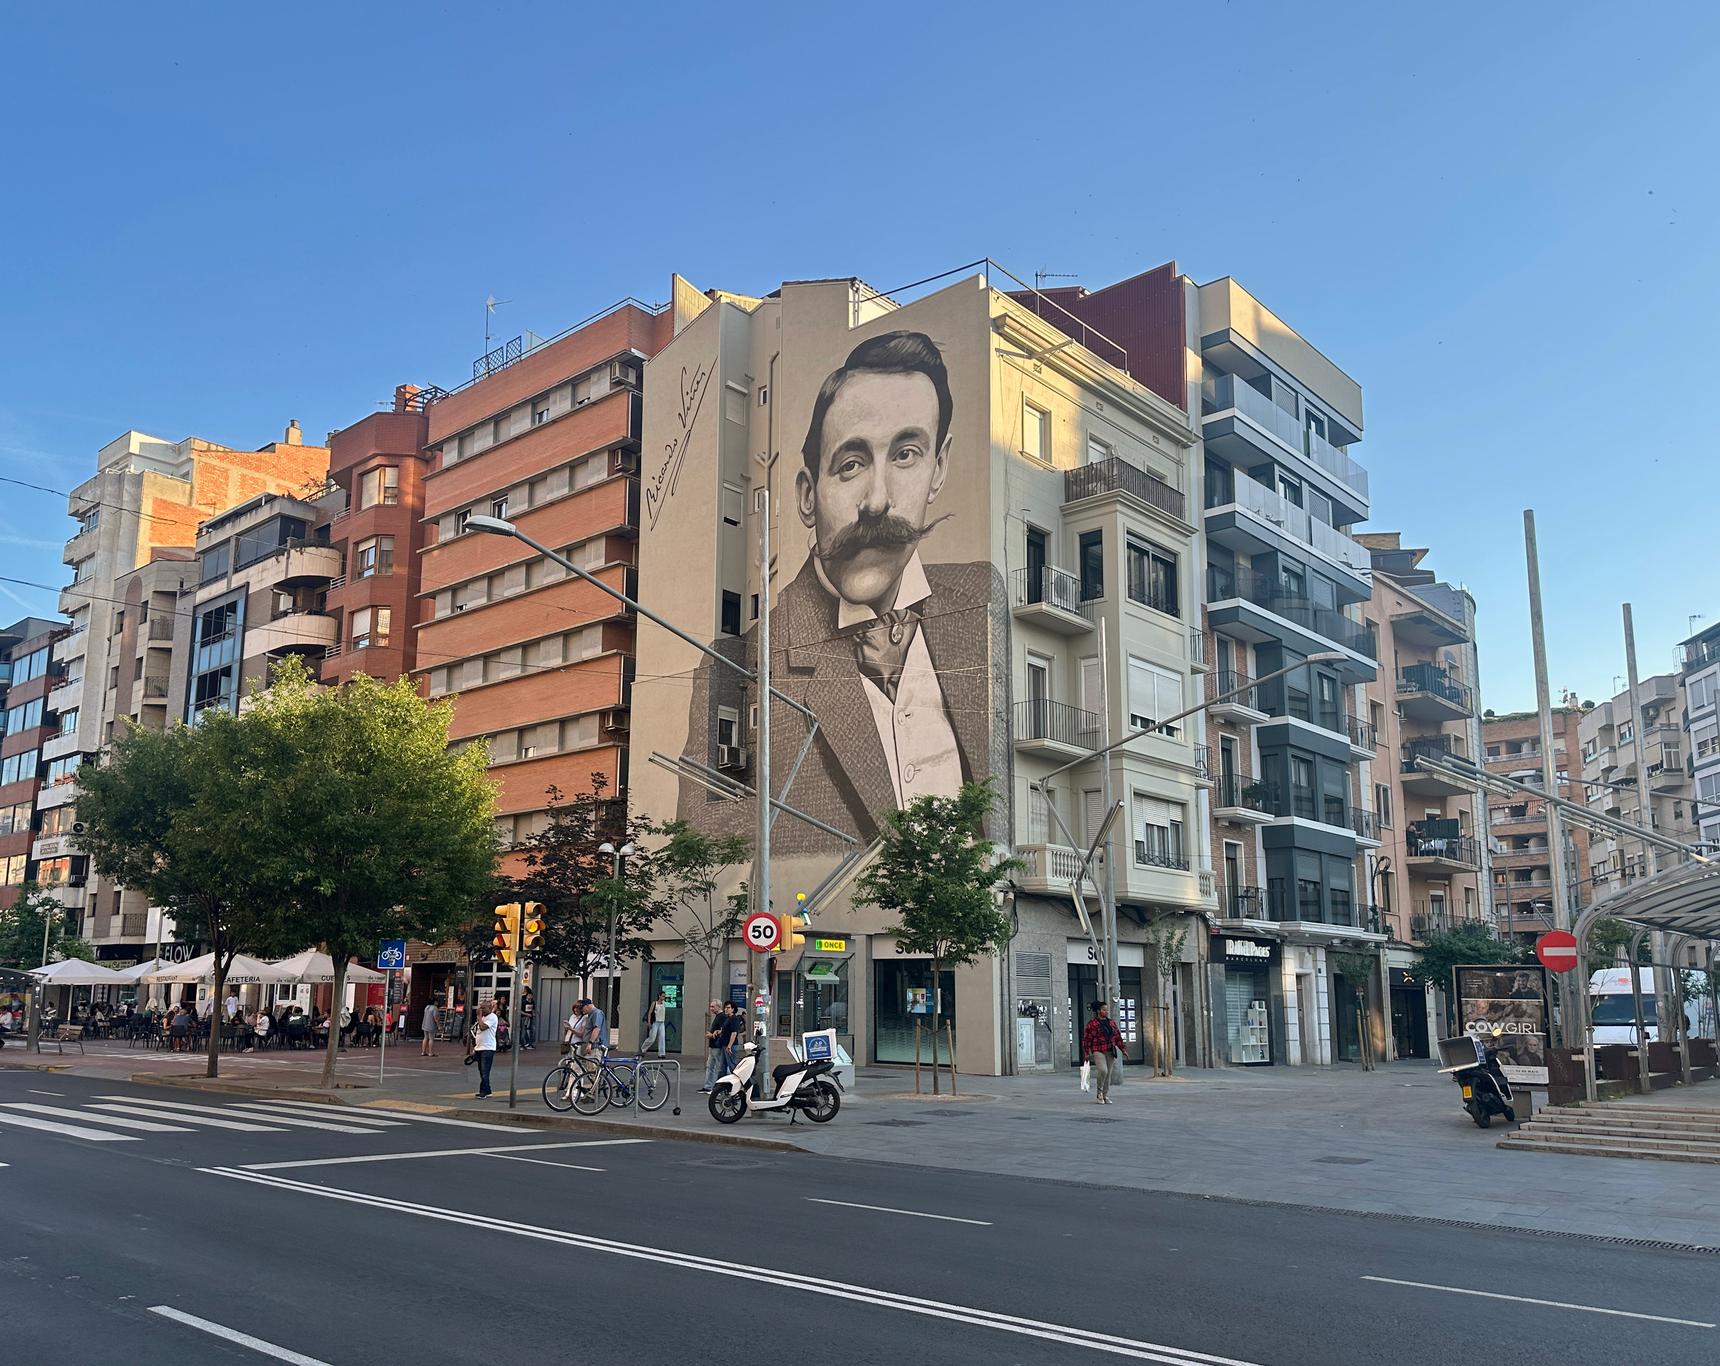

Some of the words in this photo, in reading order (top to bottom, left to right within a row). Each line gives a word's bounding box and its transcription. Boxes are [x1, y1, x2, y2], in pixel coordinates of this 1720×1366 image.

[751, 925, 774, 939] 50
[823, 941, 843, 950] ONCE
[164, 945, 195, 964] FLOW
[1465, 1021, 1537, 1034] COWGIRL
